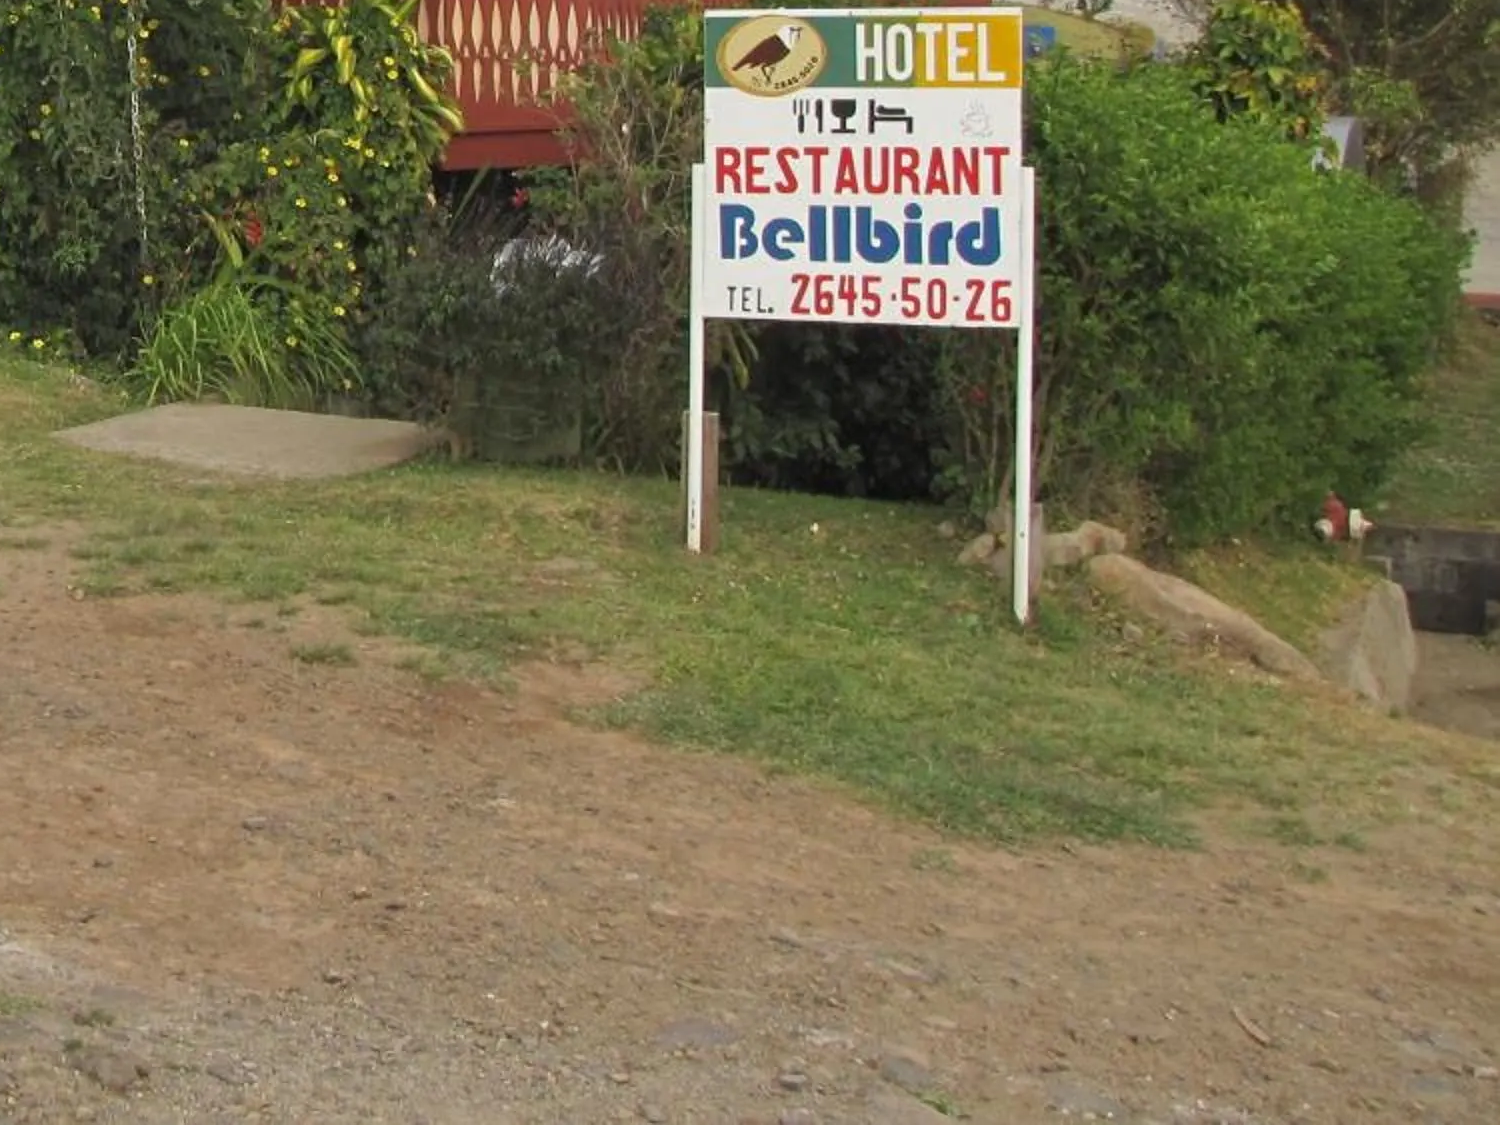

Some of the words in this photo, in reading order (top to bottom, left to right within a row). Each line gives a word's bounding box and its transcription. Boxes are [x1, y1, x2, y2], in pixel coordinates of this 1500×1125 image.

[854, 22, 1006, 82] HOTEL
[714, 146, 1010, 195] RESTAURANT
[719, 203, 1001, 266] Bellbird
[726, 286, 774, 313] TEL.
